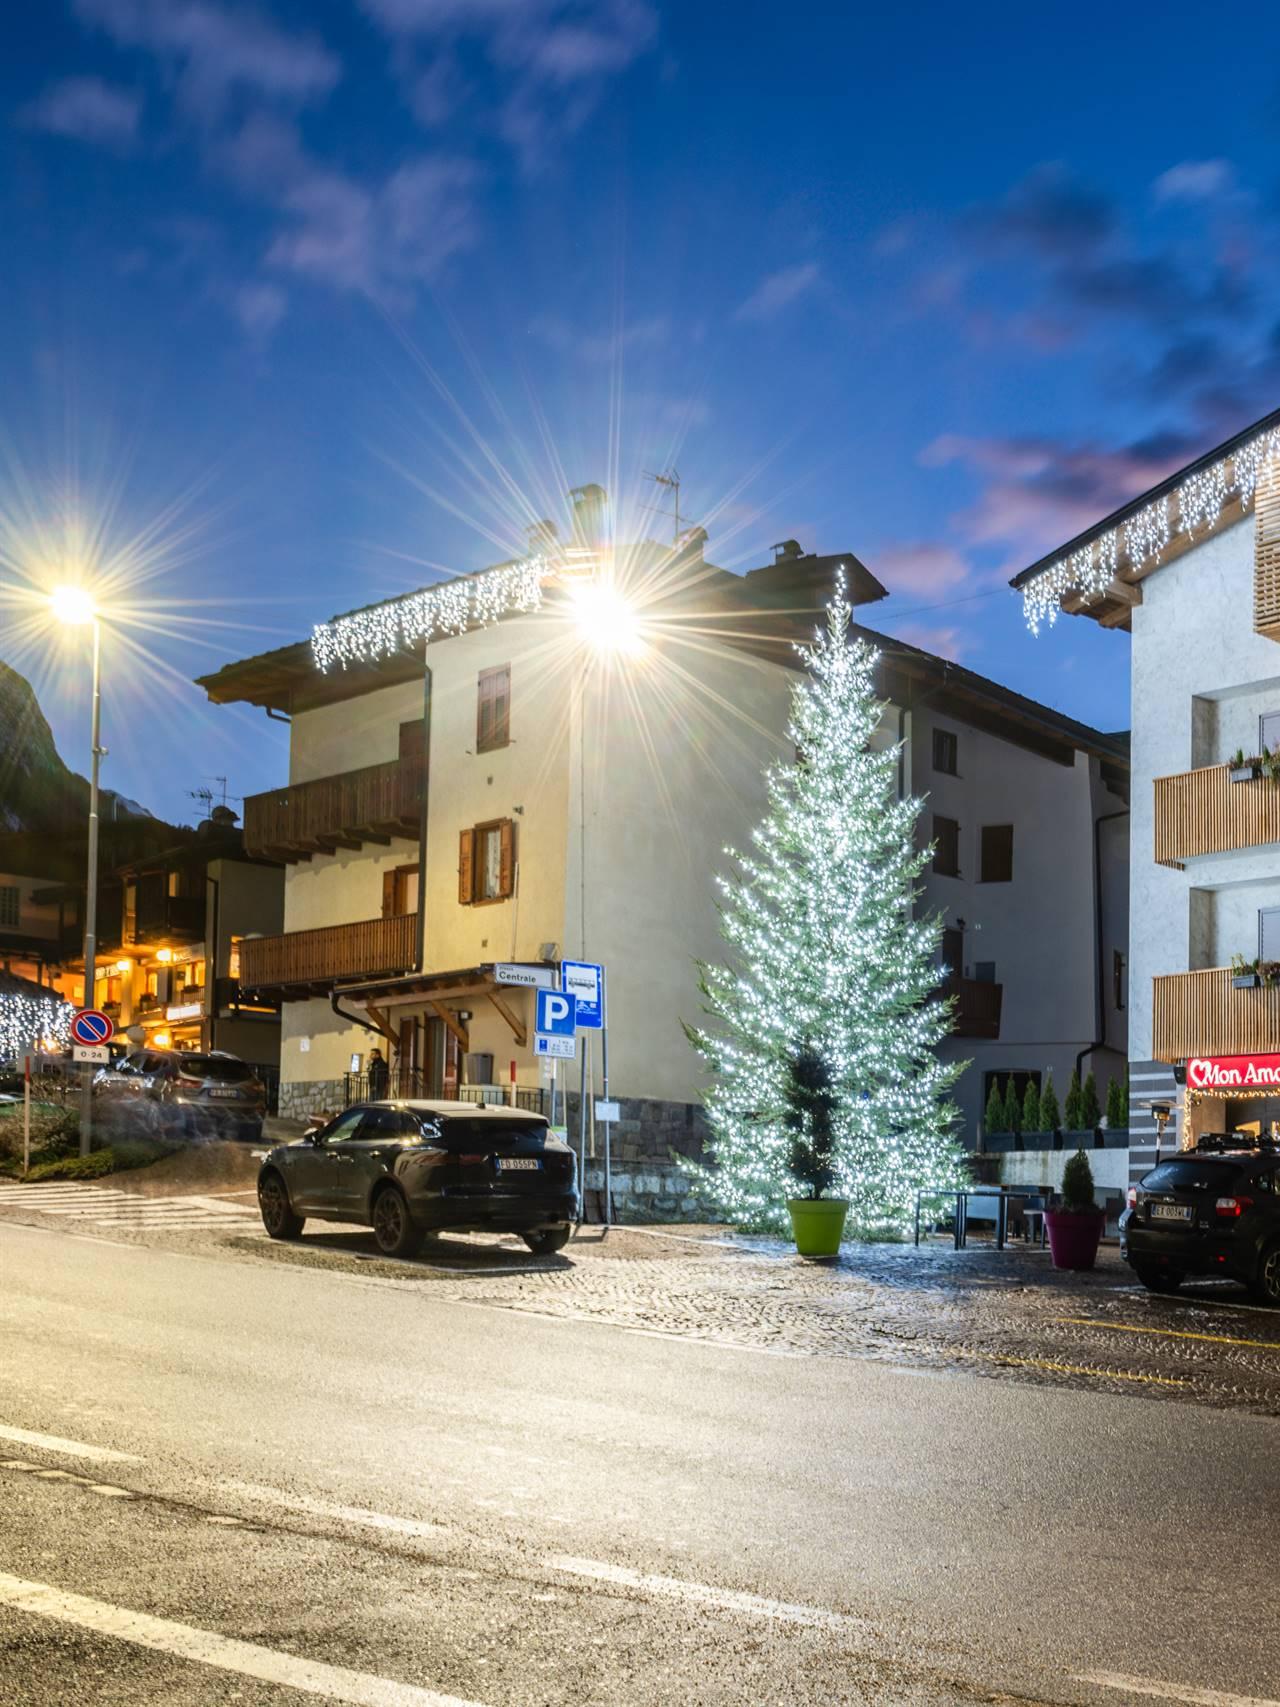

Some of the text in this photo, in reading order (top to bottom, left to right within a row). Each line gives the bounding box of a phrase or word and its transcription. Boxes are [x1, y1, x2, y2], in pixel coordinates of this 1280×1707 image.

[498, 971, 537, 984] Centrale
[544, 994, 570, 1031] P
[1203, 1064, 1242, 1085] Mon
